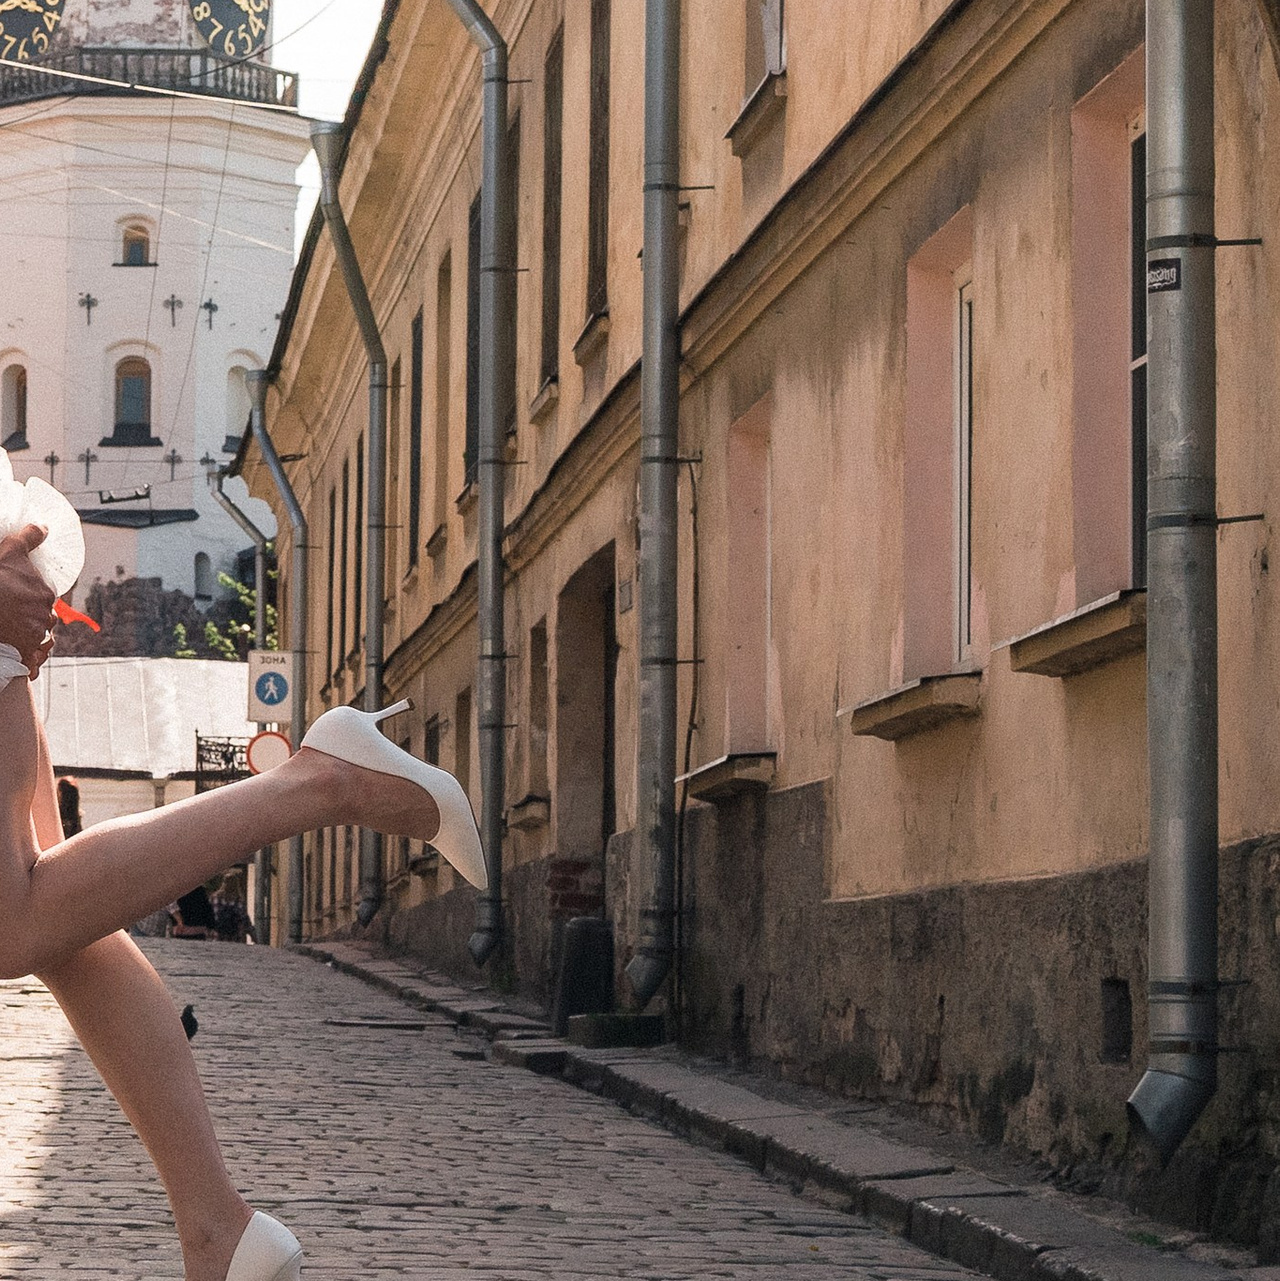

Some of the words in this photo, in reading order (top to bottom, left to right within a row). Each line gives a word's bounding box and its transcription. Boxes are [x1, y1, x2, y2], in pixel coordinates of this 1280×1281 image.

[43, 11, 61, 32] 4
[193, 2, 211, 21] 8
[209, 18, 224, 44] 7
[238, 24, 252, 54] 5
[249, 15, 266, 38] 4
[1, 34, 17, 60] 7
[32, 26, 48, 54] 5
[224, 30, 236, 56] 6
[260, 656, 286, 664] ЗОНА
